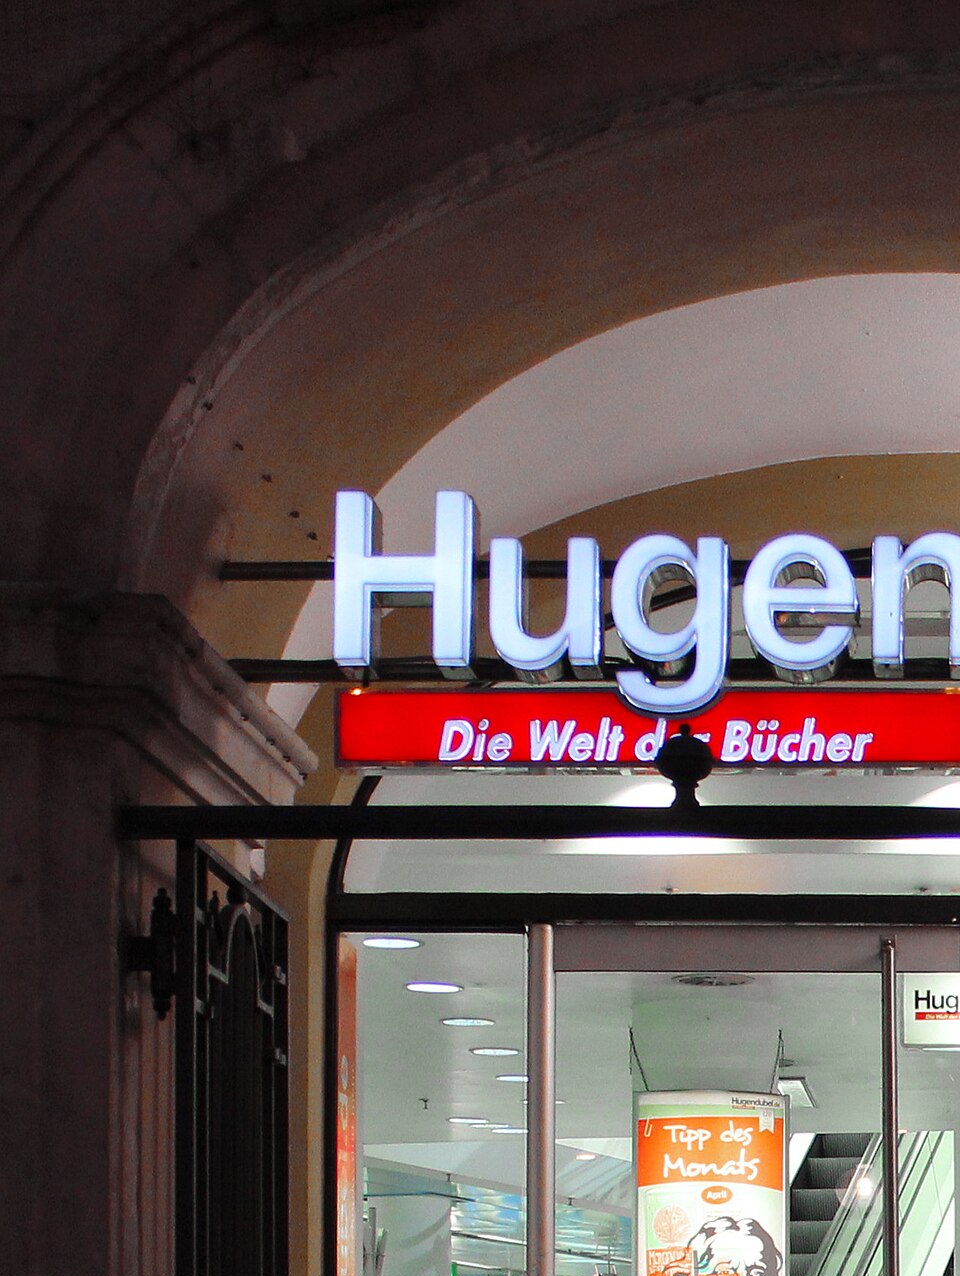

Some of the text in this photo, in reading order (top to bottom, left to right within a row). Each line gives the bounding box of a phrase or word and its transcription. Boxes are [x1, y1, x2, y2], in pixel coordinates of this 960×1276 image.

[438, 718, 513, 761] Die
[529, 717, 625, 761] Welt
[720, 717, 875, 762] Bücher
[663, 1120, 754, 1151] Tipp des
[663, 1148, 760, 1181] Monats
[706, 1190, 727, 1201] April
